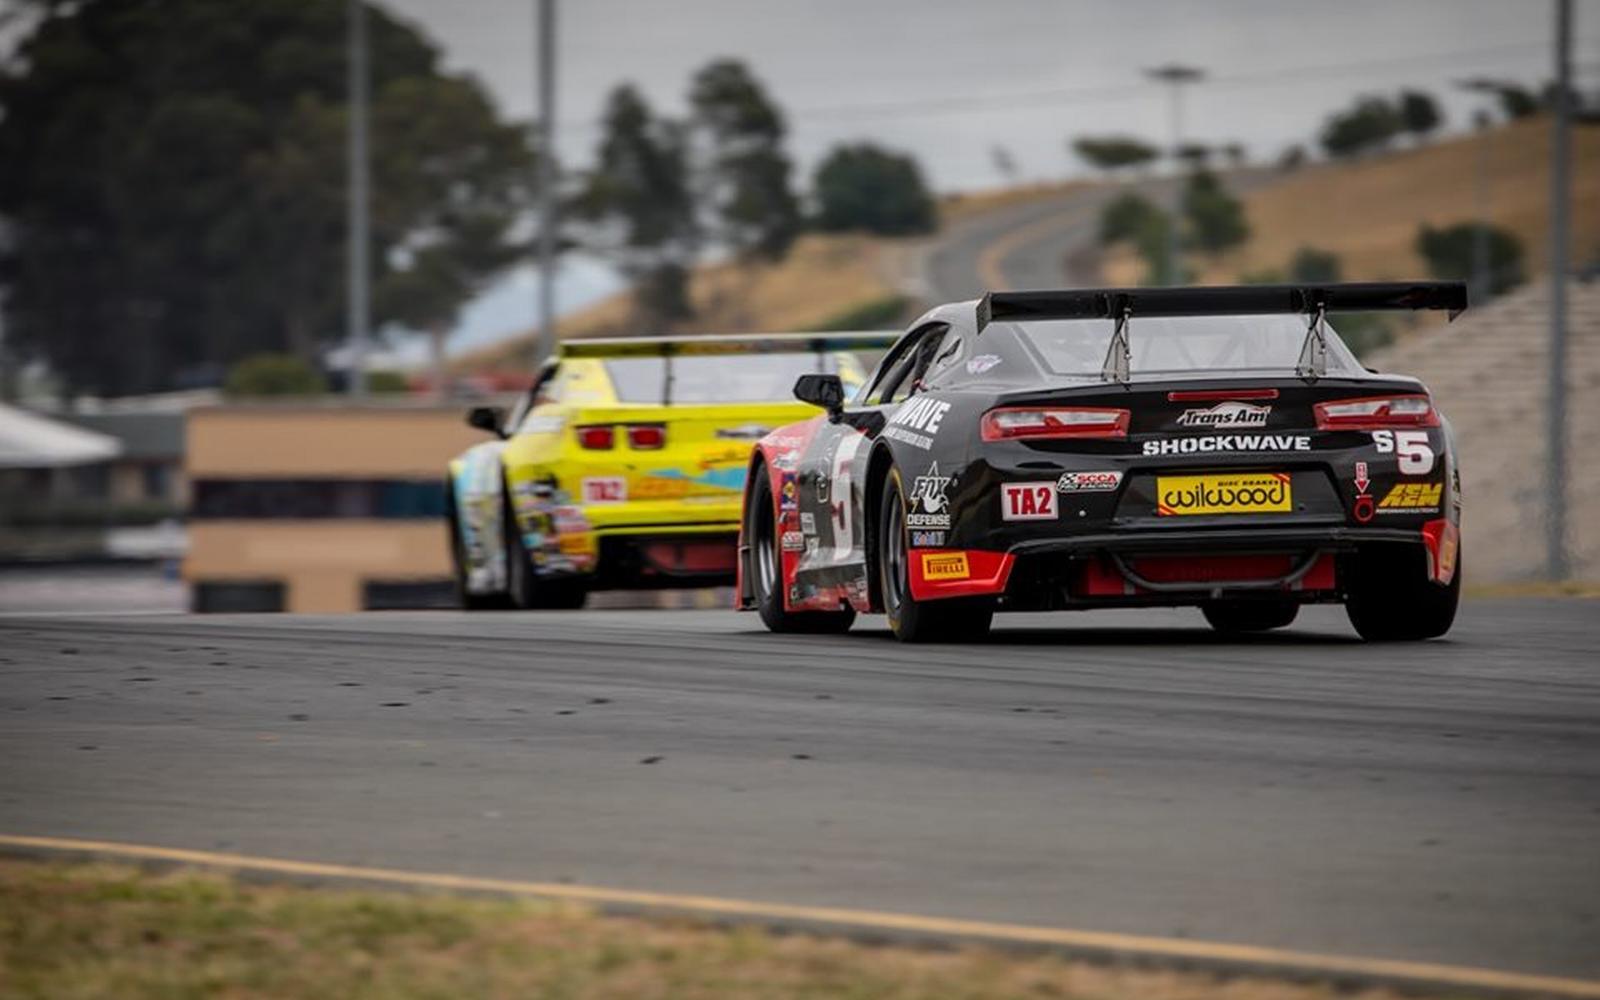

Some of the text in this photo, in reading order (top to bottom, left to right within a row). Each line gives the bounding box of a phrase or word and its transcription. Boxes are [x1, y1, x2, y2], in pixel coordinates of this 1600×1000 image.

[1183, 409, 1265, 424] Trans Am
[1143, 436, 1311, 455] SHOCKWAVE
[1077, 474, 1116, 484] SCCA
[1007, 487, 1052, 515] TA2
[1378, 483, 1443, 507] AEM
[907, 514, 951, 525] DEFENSE
[926, 557, 964, 574] PIRELLI
